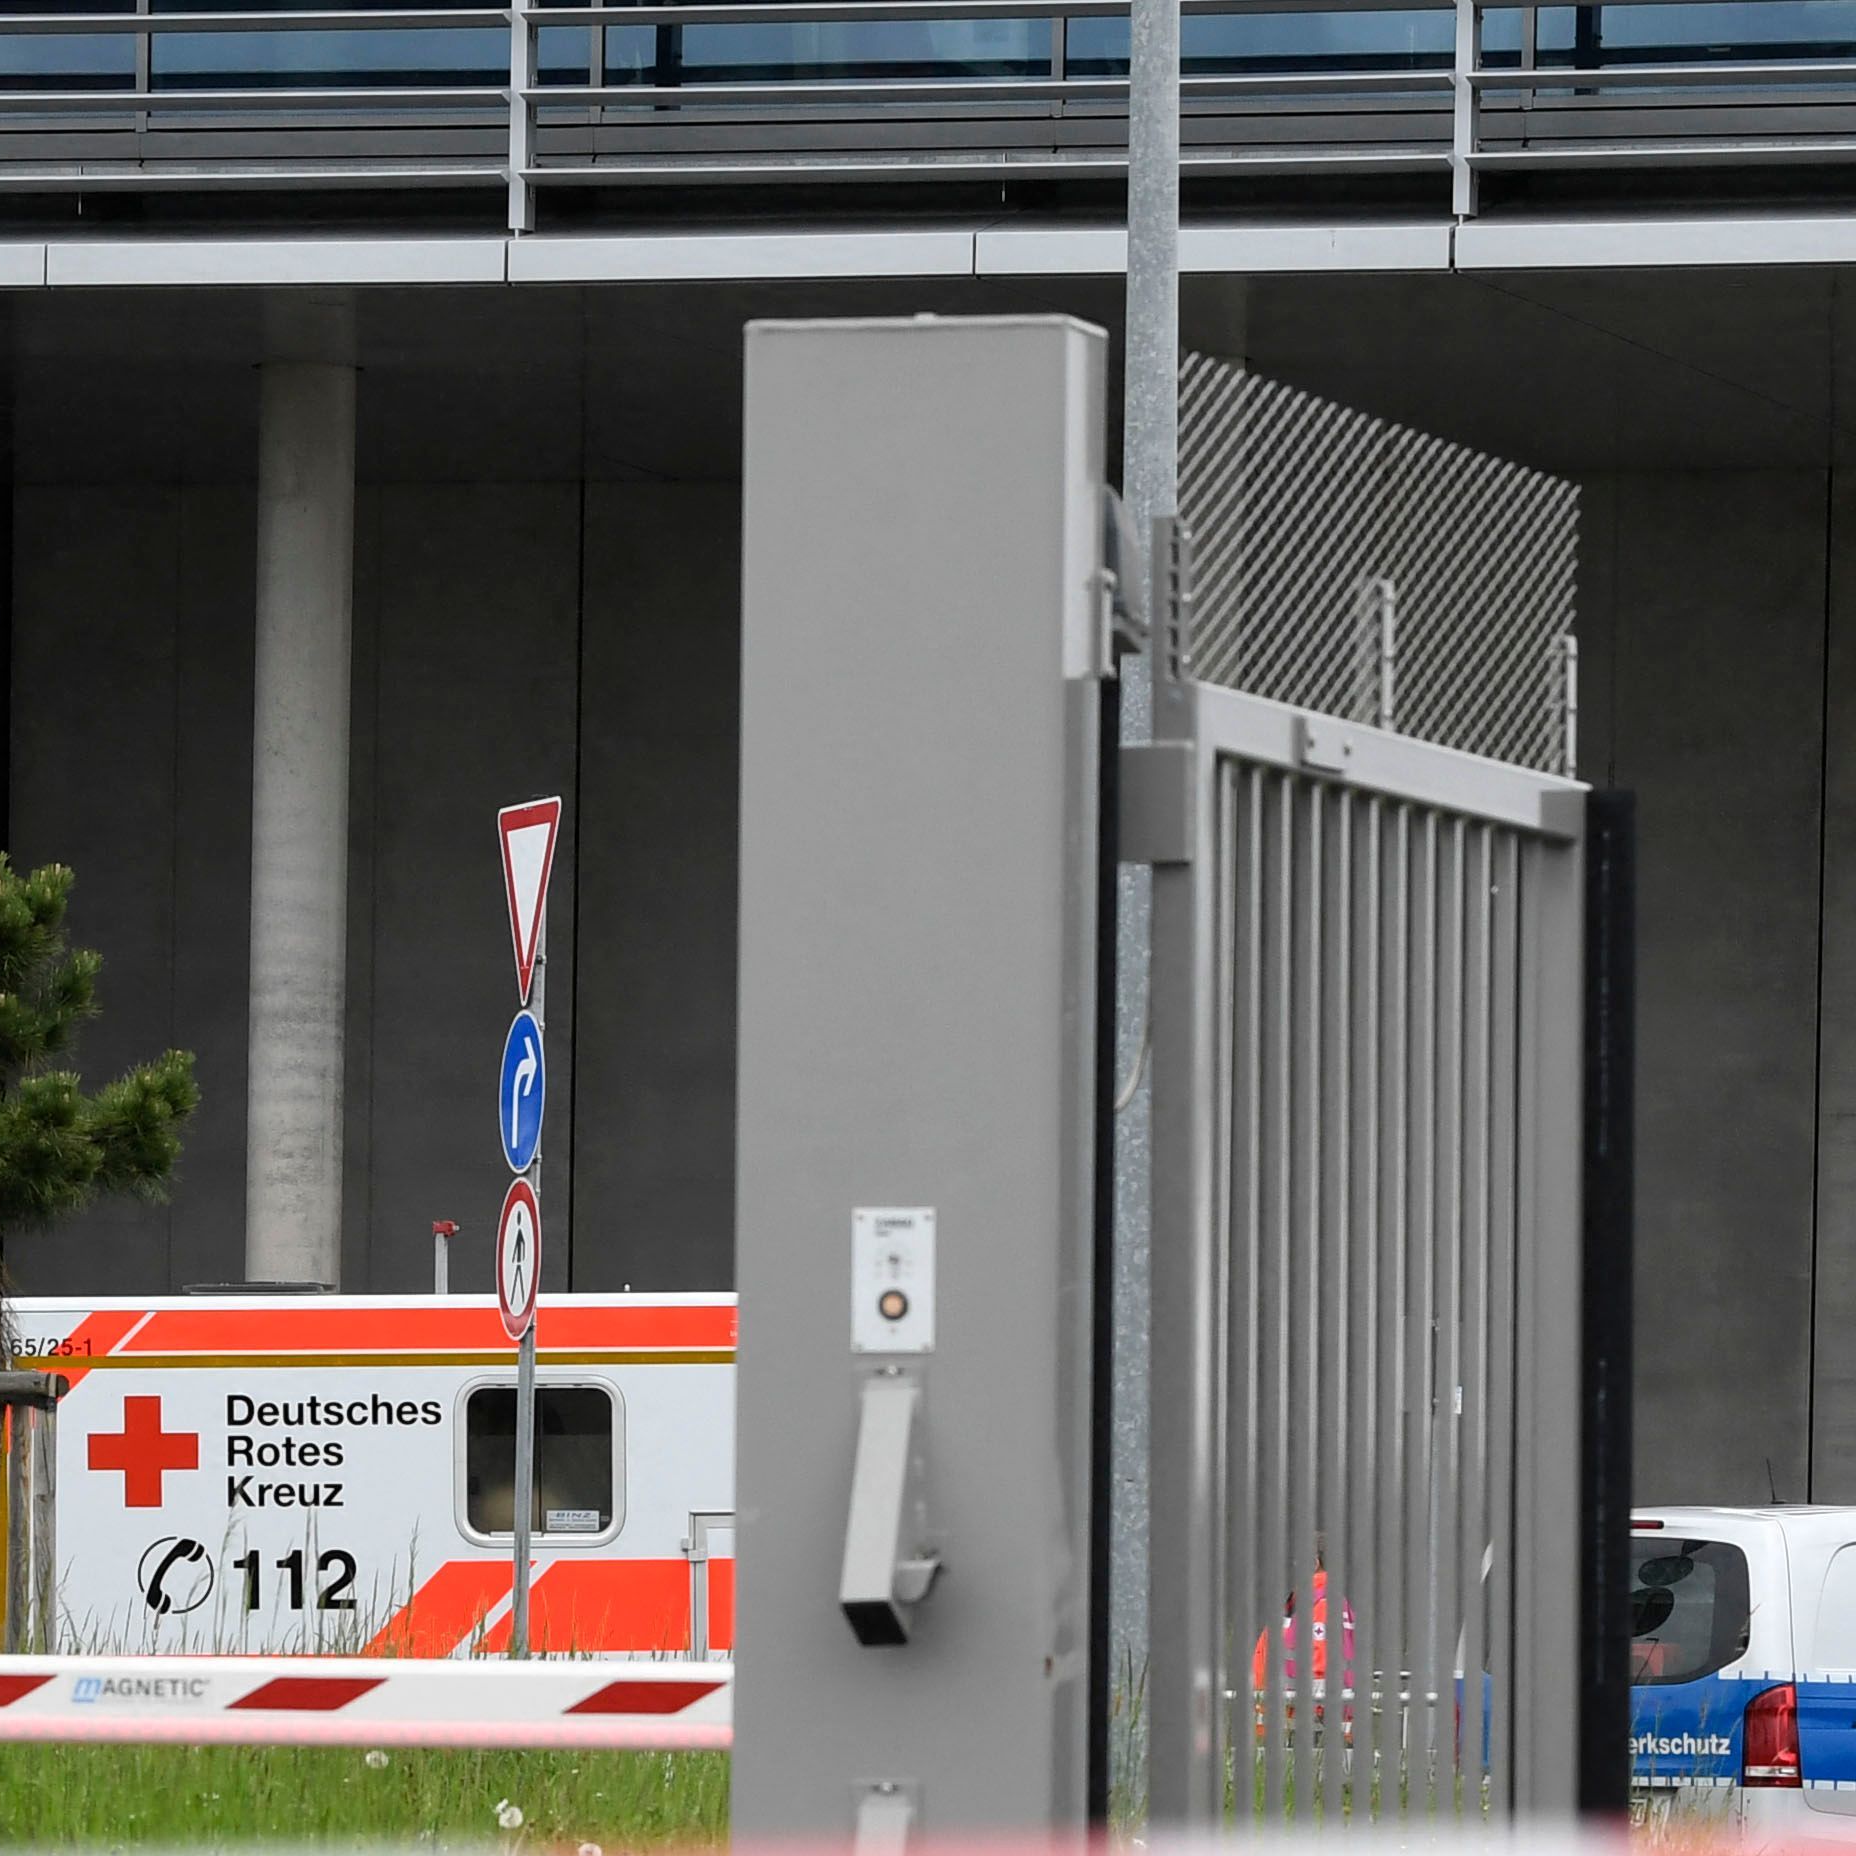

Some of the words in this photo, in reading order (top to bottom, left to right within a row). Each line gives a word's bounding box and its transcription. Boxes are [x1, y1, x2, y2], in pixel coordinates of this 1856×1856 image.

[10, 1336, 92, 1356] 65/25-1
[226, 1393, 443, 1426] Deutsches
[227, 1435, 345, 1467] Rotes
[227, 1475, 345, 1507] Kreuz
[233, 1549, 358, 1610] 112
[1628, 1732, 1731, 1755] erkschutz
